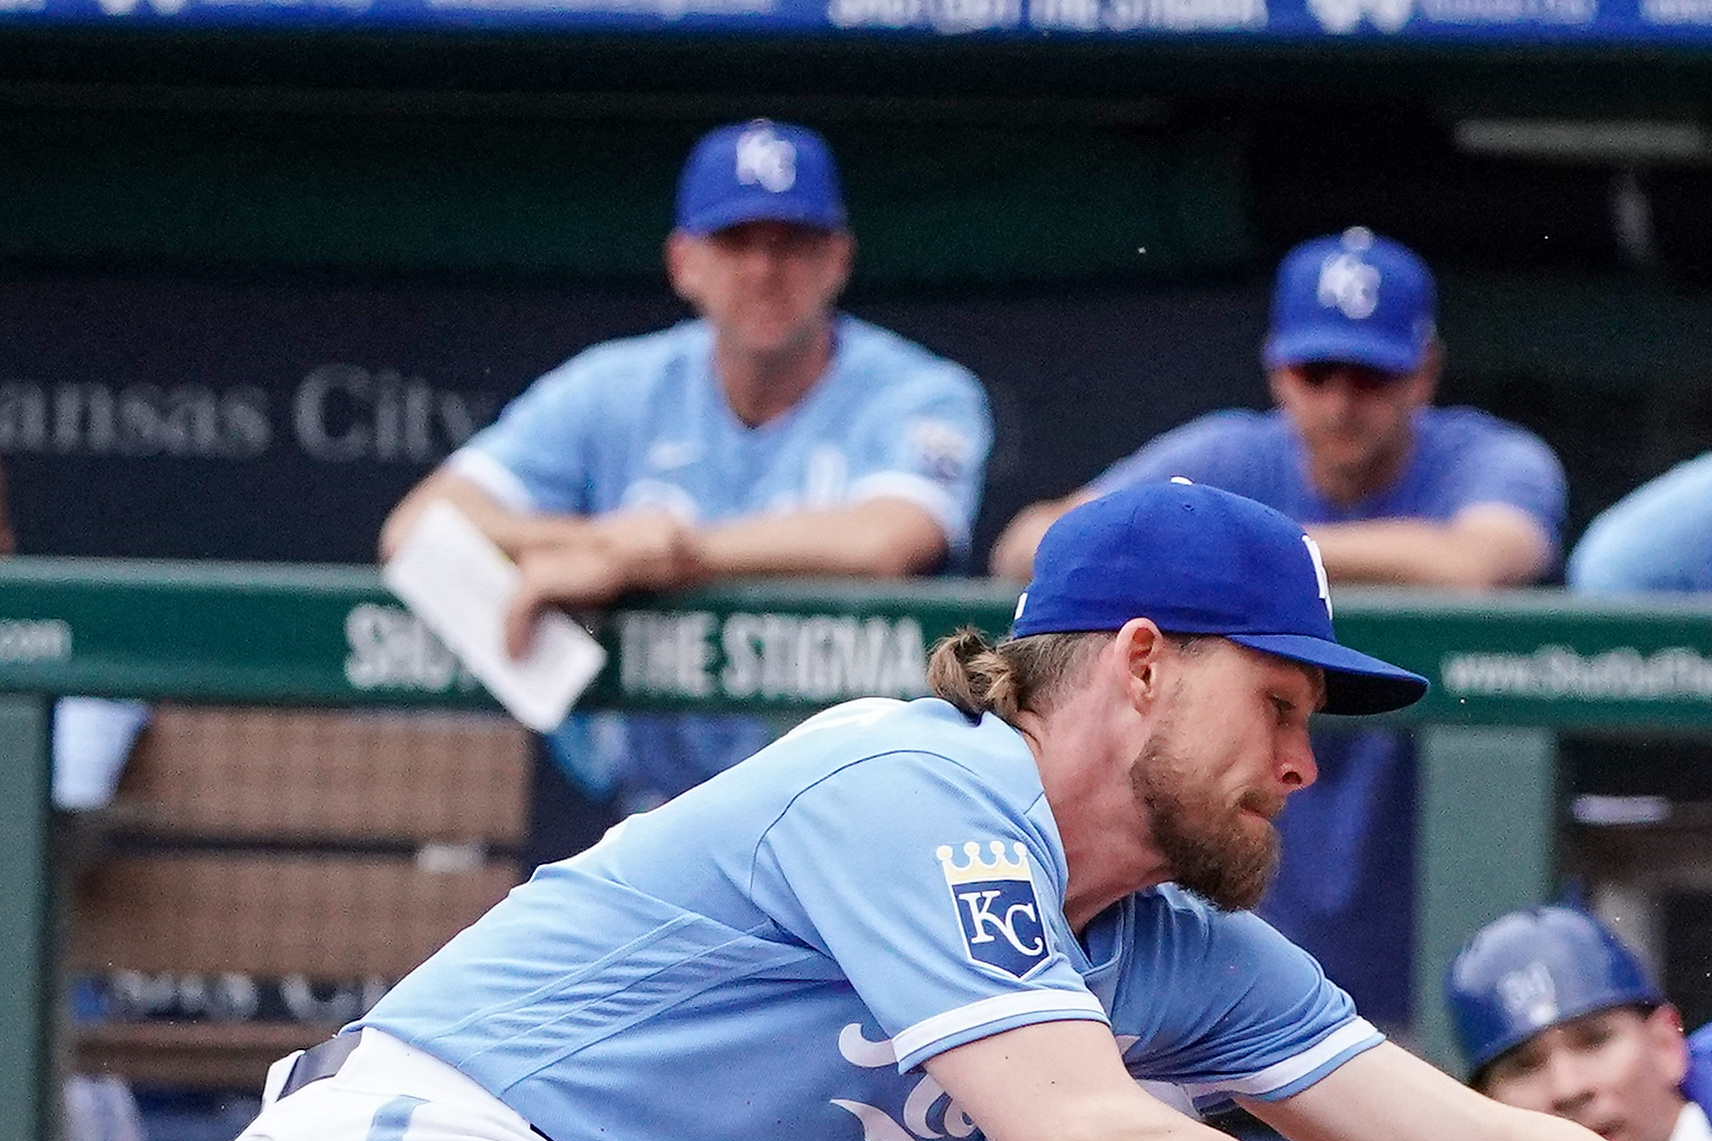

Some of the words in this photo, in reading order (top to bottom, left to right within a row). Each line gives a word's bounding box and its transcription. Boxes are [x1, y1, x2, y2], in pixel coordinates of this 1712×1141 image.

[344, 602, 478, 691] SHU
[621, 611, 719, 695] THE
[721, 612, 930, 699] STIGMA
[957, 889, 1044, 957] KC
